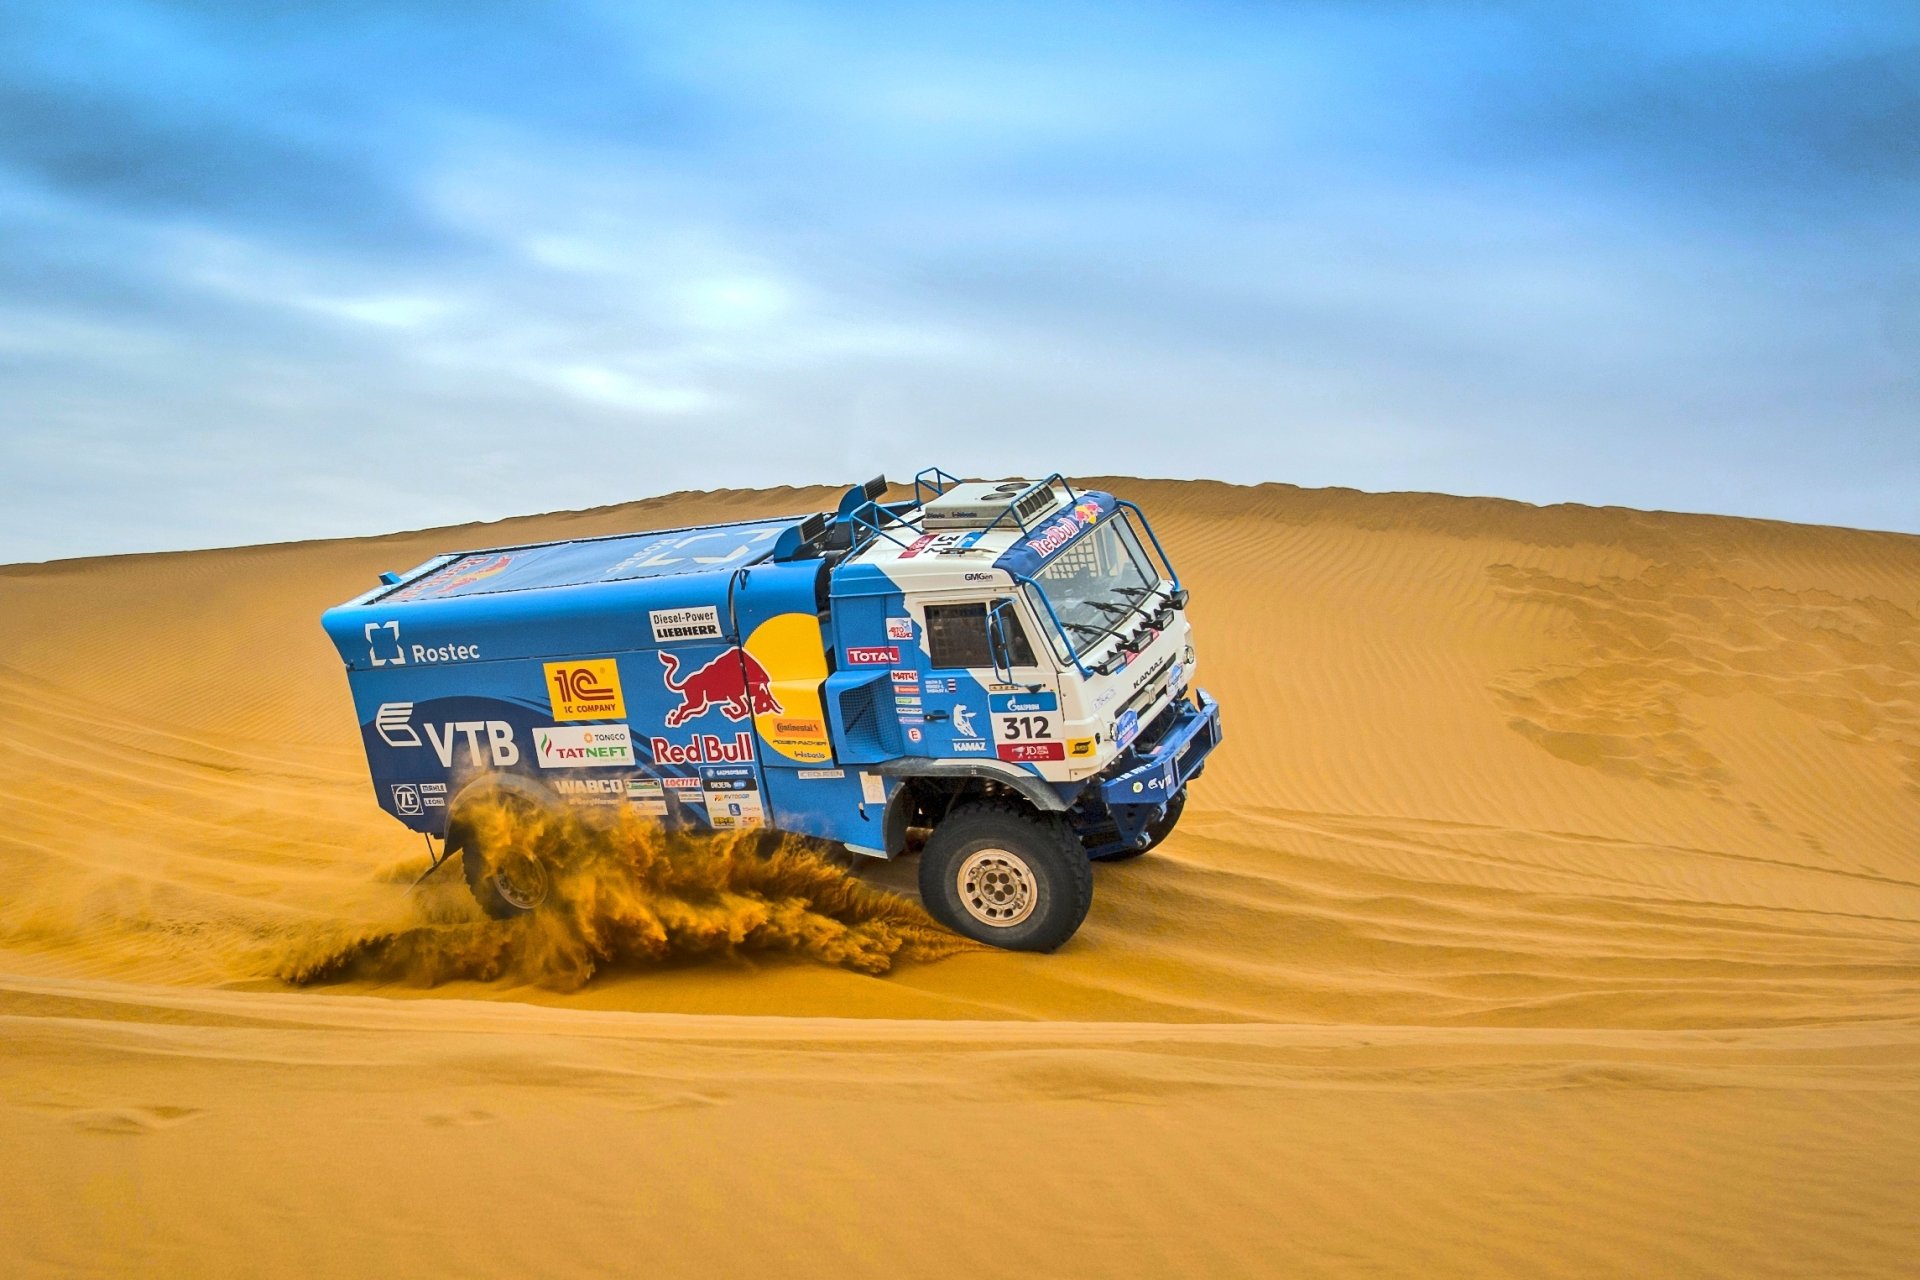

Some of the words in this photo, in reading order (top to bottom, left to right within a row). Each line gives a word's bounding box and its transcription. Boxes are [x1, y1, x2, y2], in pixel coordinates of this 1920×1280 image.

[1027, 529, 1059, 558] Red
[1054, 517, 1080, 545] Bull
[652, 611, 714, 625] Diesel-Power
[656, 624, 718, 639] LIEBHERR
[411, 643, 481, 663] Rostec
[849, 651, 898, 662] TOTAL
[576, 704, 616, 713] COMPANY
[1002, 715, 1051, 740] 312
[423, 720, 520, 767] VTB
[650, 734, 704, 765] Red
[702, 732, 755, 763] Bull
[952, 742, 987, 752] KAMAZ
[555, 746, 628, 759] TATNEFT
[554, 779, 624, 794] WABCO
[664, 778, 699, 788] LOCTITE
